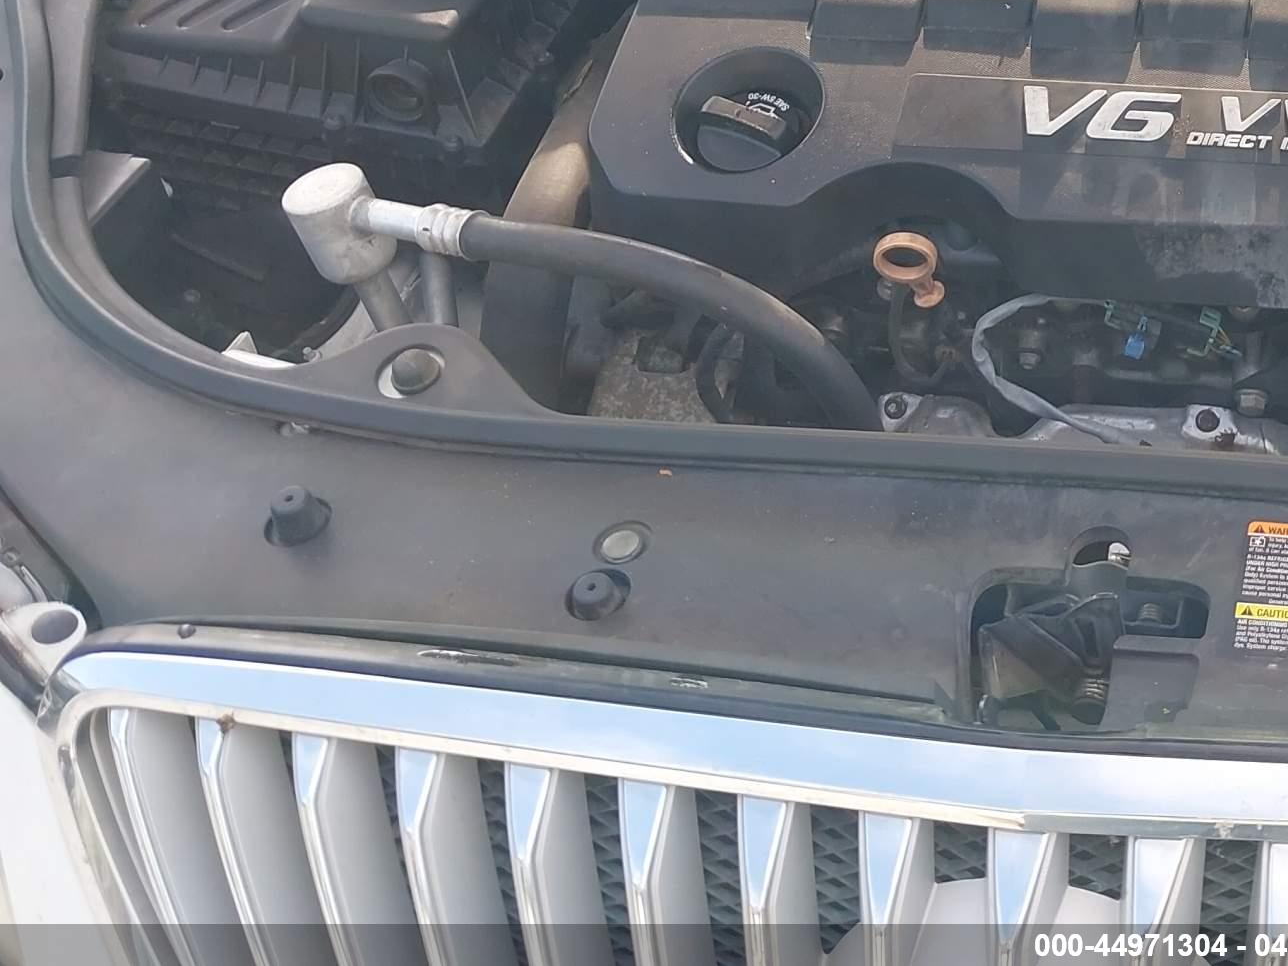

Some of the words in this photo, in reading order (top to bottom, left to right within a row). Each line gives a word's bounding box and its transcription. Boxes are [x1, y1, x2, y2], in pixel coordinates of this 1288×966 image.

[775, 98, 789, 111] SAE
[1023, 85, 1182, 141] V6
[1186, 133, 1272, 149] DIRECT
